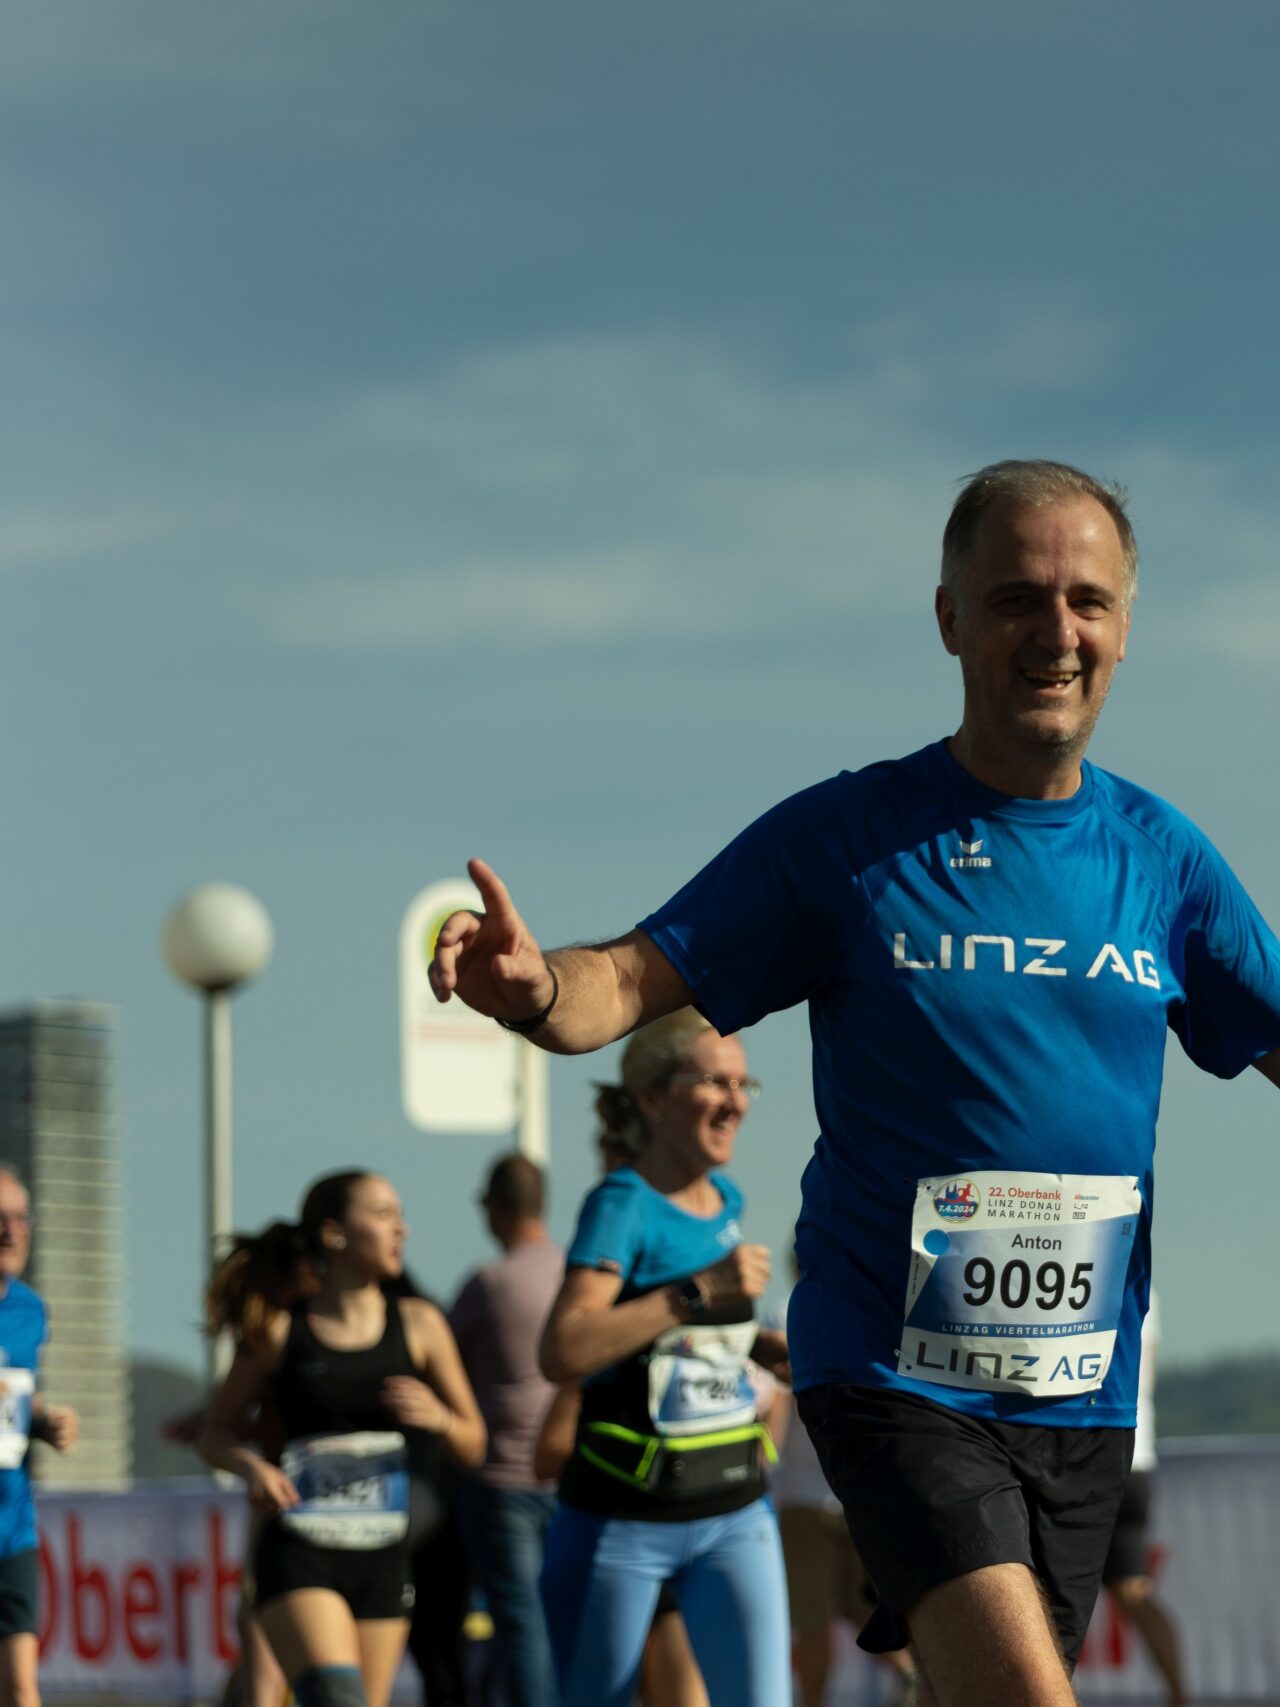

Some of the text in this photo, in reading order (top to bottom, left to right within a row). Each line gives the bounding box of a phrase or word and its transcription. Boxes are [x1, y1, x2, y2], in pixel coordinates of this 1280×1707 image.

[950, 855, 992, 868] erima
[894, 932, 1161, 990] LINZ AG
[988, 1187, 1005, 1197] 22.
[1008, 1188, 1062, 1200] Oberbank
[938, 1204, 975, 1213] 7.4.2024
[987, 1199, 1062, 1211] LINZ DONAU
[987, 1209, 1061, 1221] MARATHON
[1011, 1233, 1063, 1250] Anton
[962, 1257, 1094, 1311] 9095
[995, 1322, 1095, 1335] VIERTELMARATHON
[916, 1341, 1102, 1382] LINZ AG
